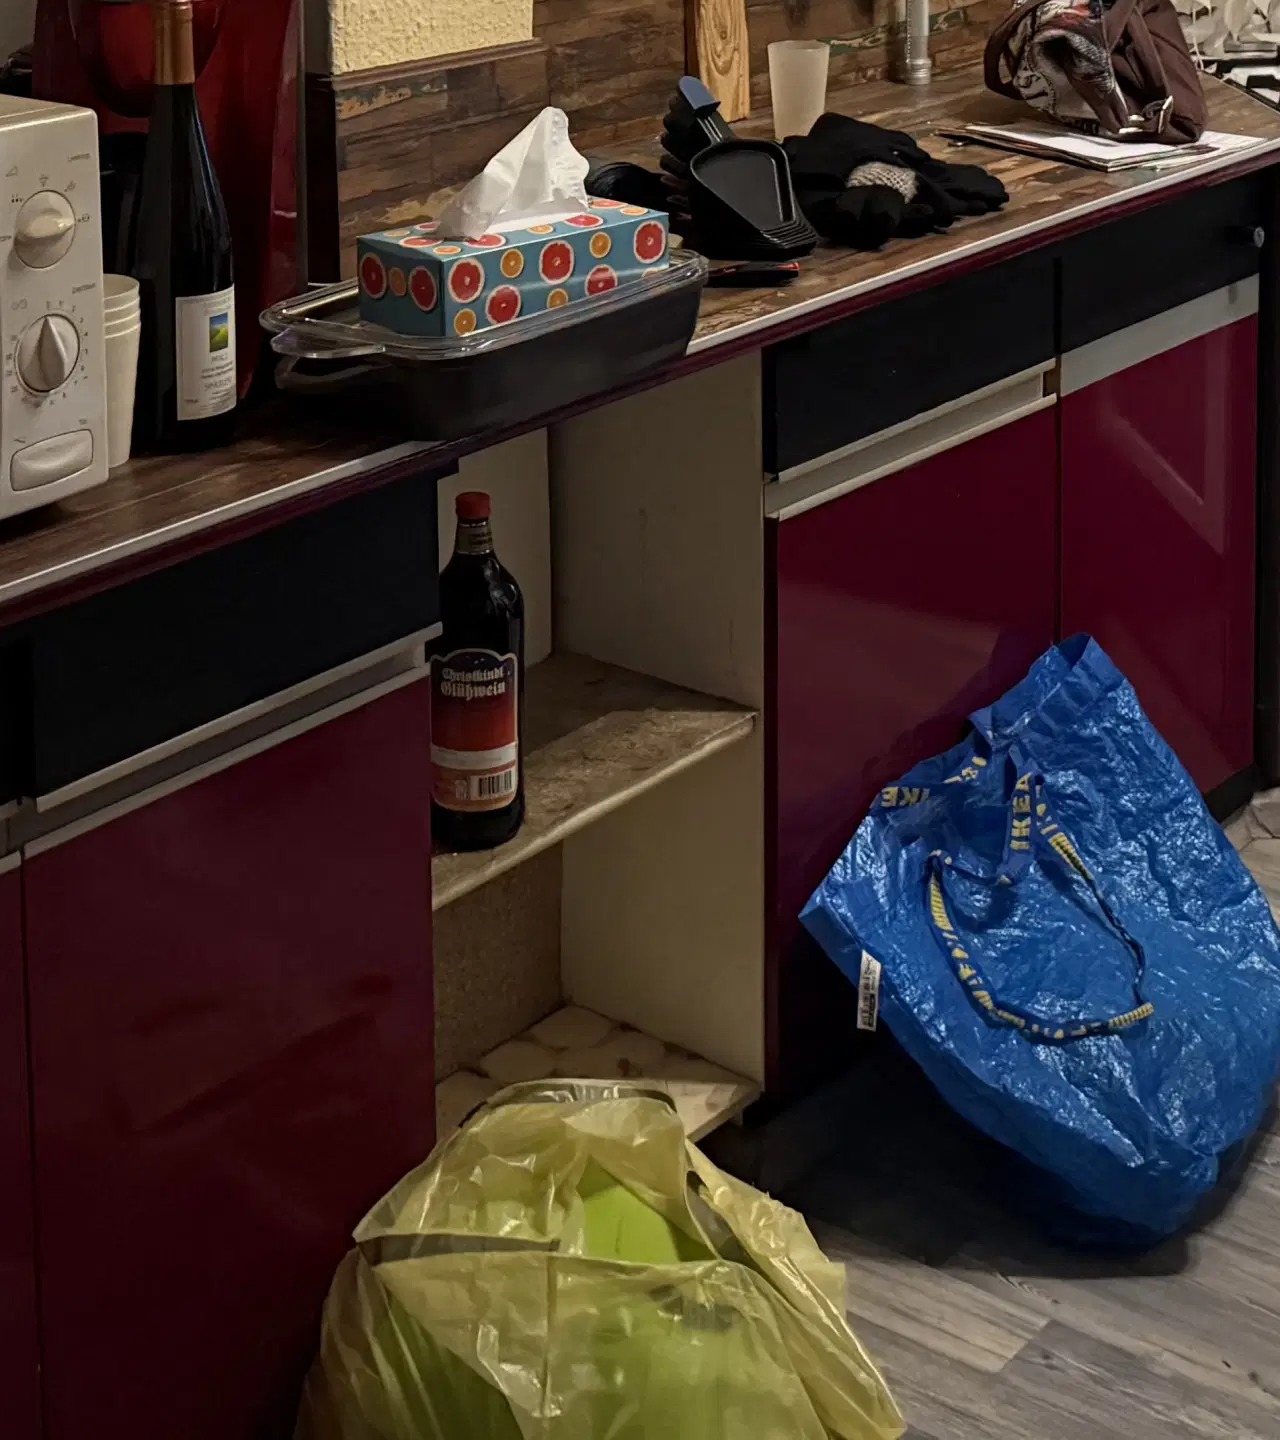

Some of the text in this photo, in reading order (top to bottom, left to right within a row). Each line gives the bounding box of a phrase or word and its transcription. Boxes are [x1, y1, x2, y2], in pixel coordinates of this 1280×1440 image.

[442, 667, 504, 682] Christkindl
[441, 680, 506, 702] Glühwein
[880, 786, 932, 809] IKE
[1009, 772, 1034, 851] IKEA
